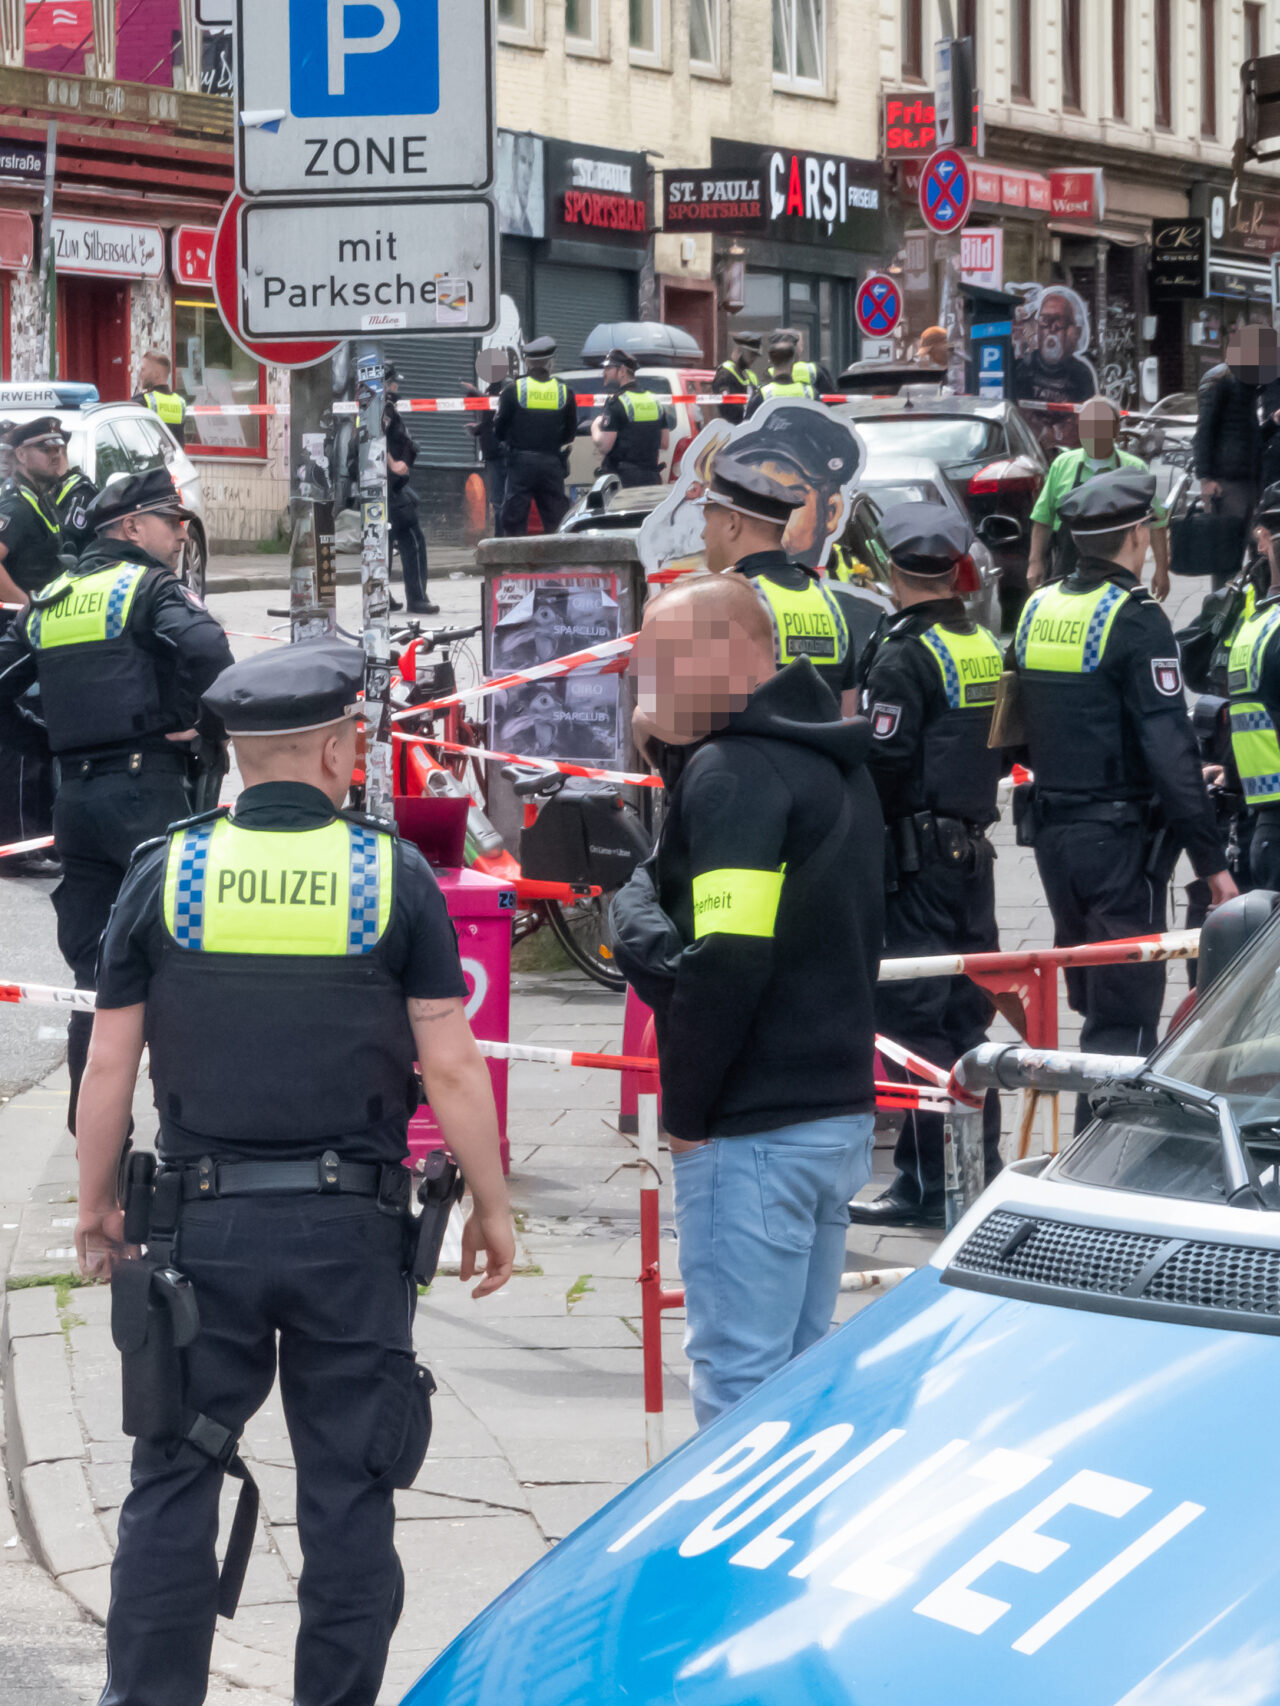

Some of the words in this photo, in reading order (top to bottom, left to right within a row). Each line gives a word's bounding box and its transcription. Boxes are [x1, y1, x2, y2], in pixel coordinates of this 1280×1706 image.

[327, 0, 401, 95] P
[304, 136, 427, 177] ZONE
[670, 182, 696, 202] ST.
[701, 180, 760, 201] PAULI
[848, 187, 879, 209] FRISEUR
[1053, 199, 1088, 212] West
[564, 190, 646, 230] SPORTSBAR
[669, 202, 760, 219] SPORTSBAR
[338, 230, 397, 262] mit
[962, 237, 993, 269] Bild
[264, 273, 473, 308] Parksche
[983, 349, 1000, 368] P
[528, 391, 557, 400] POLIZEI
[46, 592, 103, 621] POLIZEI
[783, 612, 833, 636] POLIZEI
[1031, 618, 1085, 645] POLIZEI
[219, 869, 337, 906] POLIZEI
[606, 1421, 1207, 1656] POLIZEI
